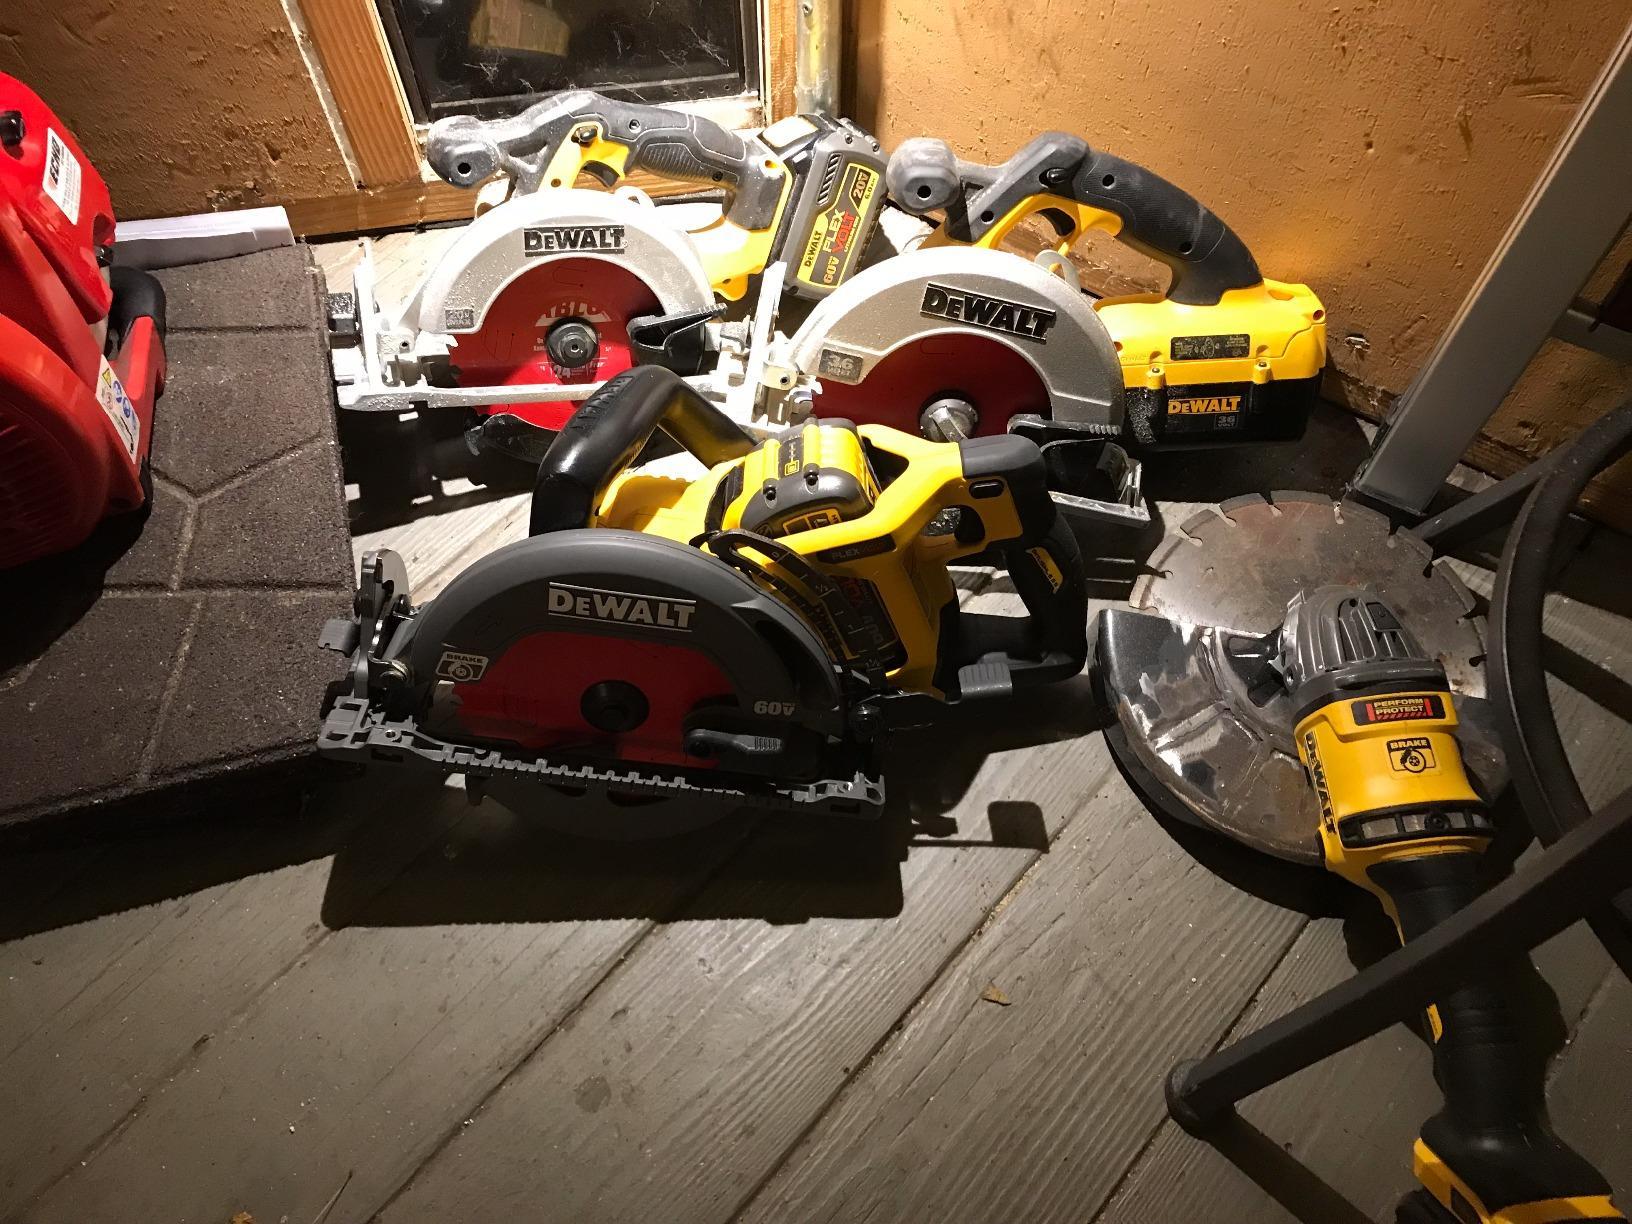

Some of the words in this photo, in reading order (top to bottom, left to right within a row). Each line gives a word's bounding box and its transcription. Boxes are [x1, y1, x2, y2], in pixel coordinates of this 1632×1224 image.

[50, 136, 61, 186] ECHO
[853, 171, 870, 199] 20V
[524, 227, 625, 252] DEWALT
[822, 208, 846, 253] FLEX
[831, 208, 856, 254] VOLT
[803, 230, 823, 268] DEWALT
[823, 255, 840, 284] 60V
[920, 285, 1055, 340] DEWALT
[828, 354, 854, 370] 36
[1167, 397, 1241, 414] DEWALT
[548, 587, 696, 629] DEWALT
[446, 653, 483, 664] BRAKE
[753, 700, 796, 716] 60V
[1373, 697, 1424, 708] PERFORM
[1375, 705, 1424, 715] PROTECT
[1389, 738, 1428, 750] BRAKE
[1305, 730, 1337, 835] DEWALT
